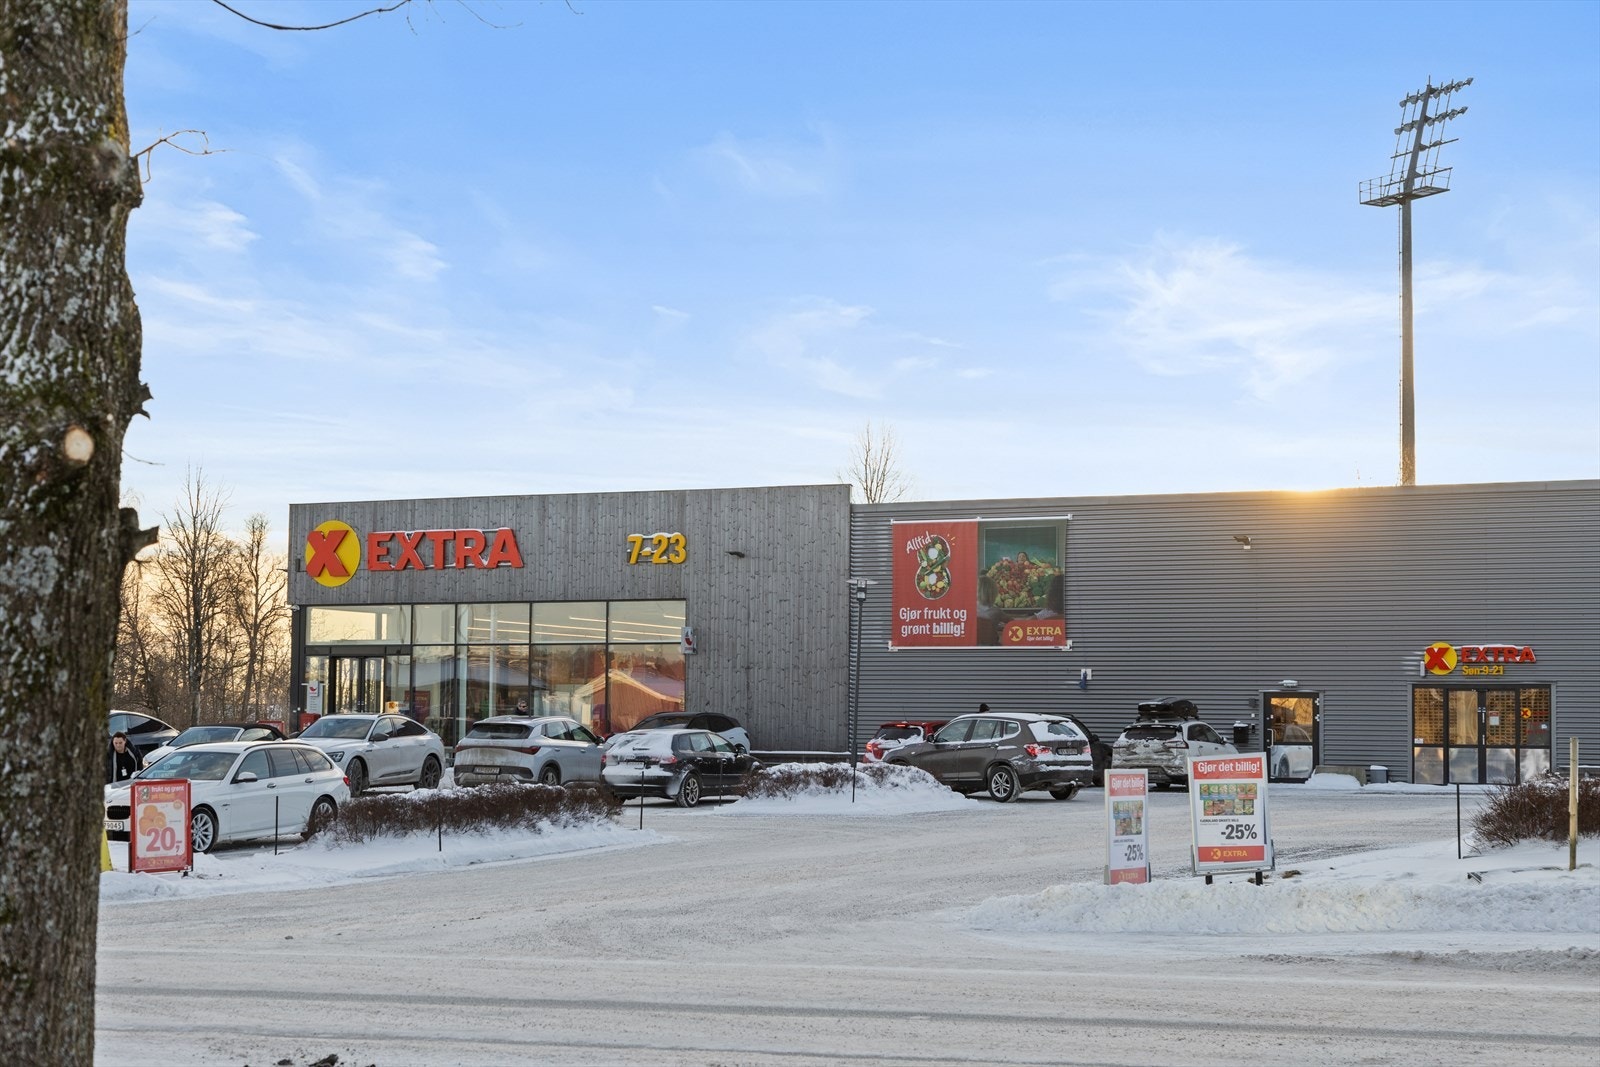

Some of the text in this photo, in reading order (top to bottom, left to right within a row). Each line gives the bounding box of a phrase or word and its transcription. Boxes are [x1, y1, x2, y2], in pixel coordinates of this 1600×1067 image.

[367, 527, 524, 571] EXTRA
[627, 532, 687, 564] 7-23
[906, 530, 931, 554] Alltid
[899, 607, 967, 622] Gjør frukt og
[901, 622, 965, 637] grønt billig!
[1026, 626, 1062, 636] EXTRA
[1461, 646, 1536, 663] EXTRA
[1198, 760, 1260, 775] Gjør det billig!
[1112, 777, 1144, 790] Gjør det billig!
[1220, 823, 1258, 840] -25%
[1124, 844, 1144, 861] -25%
